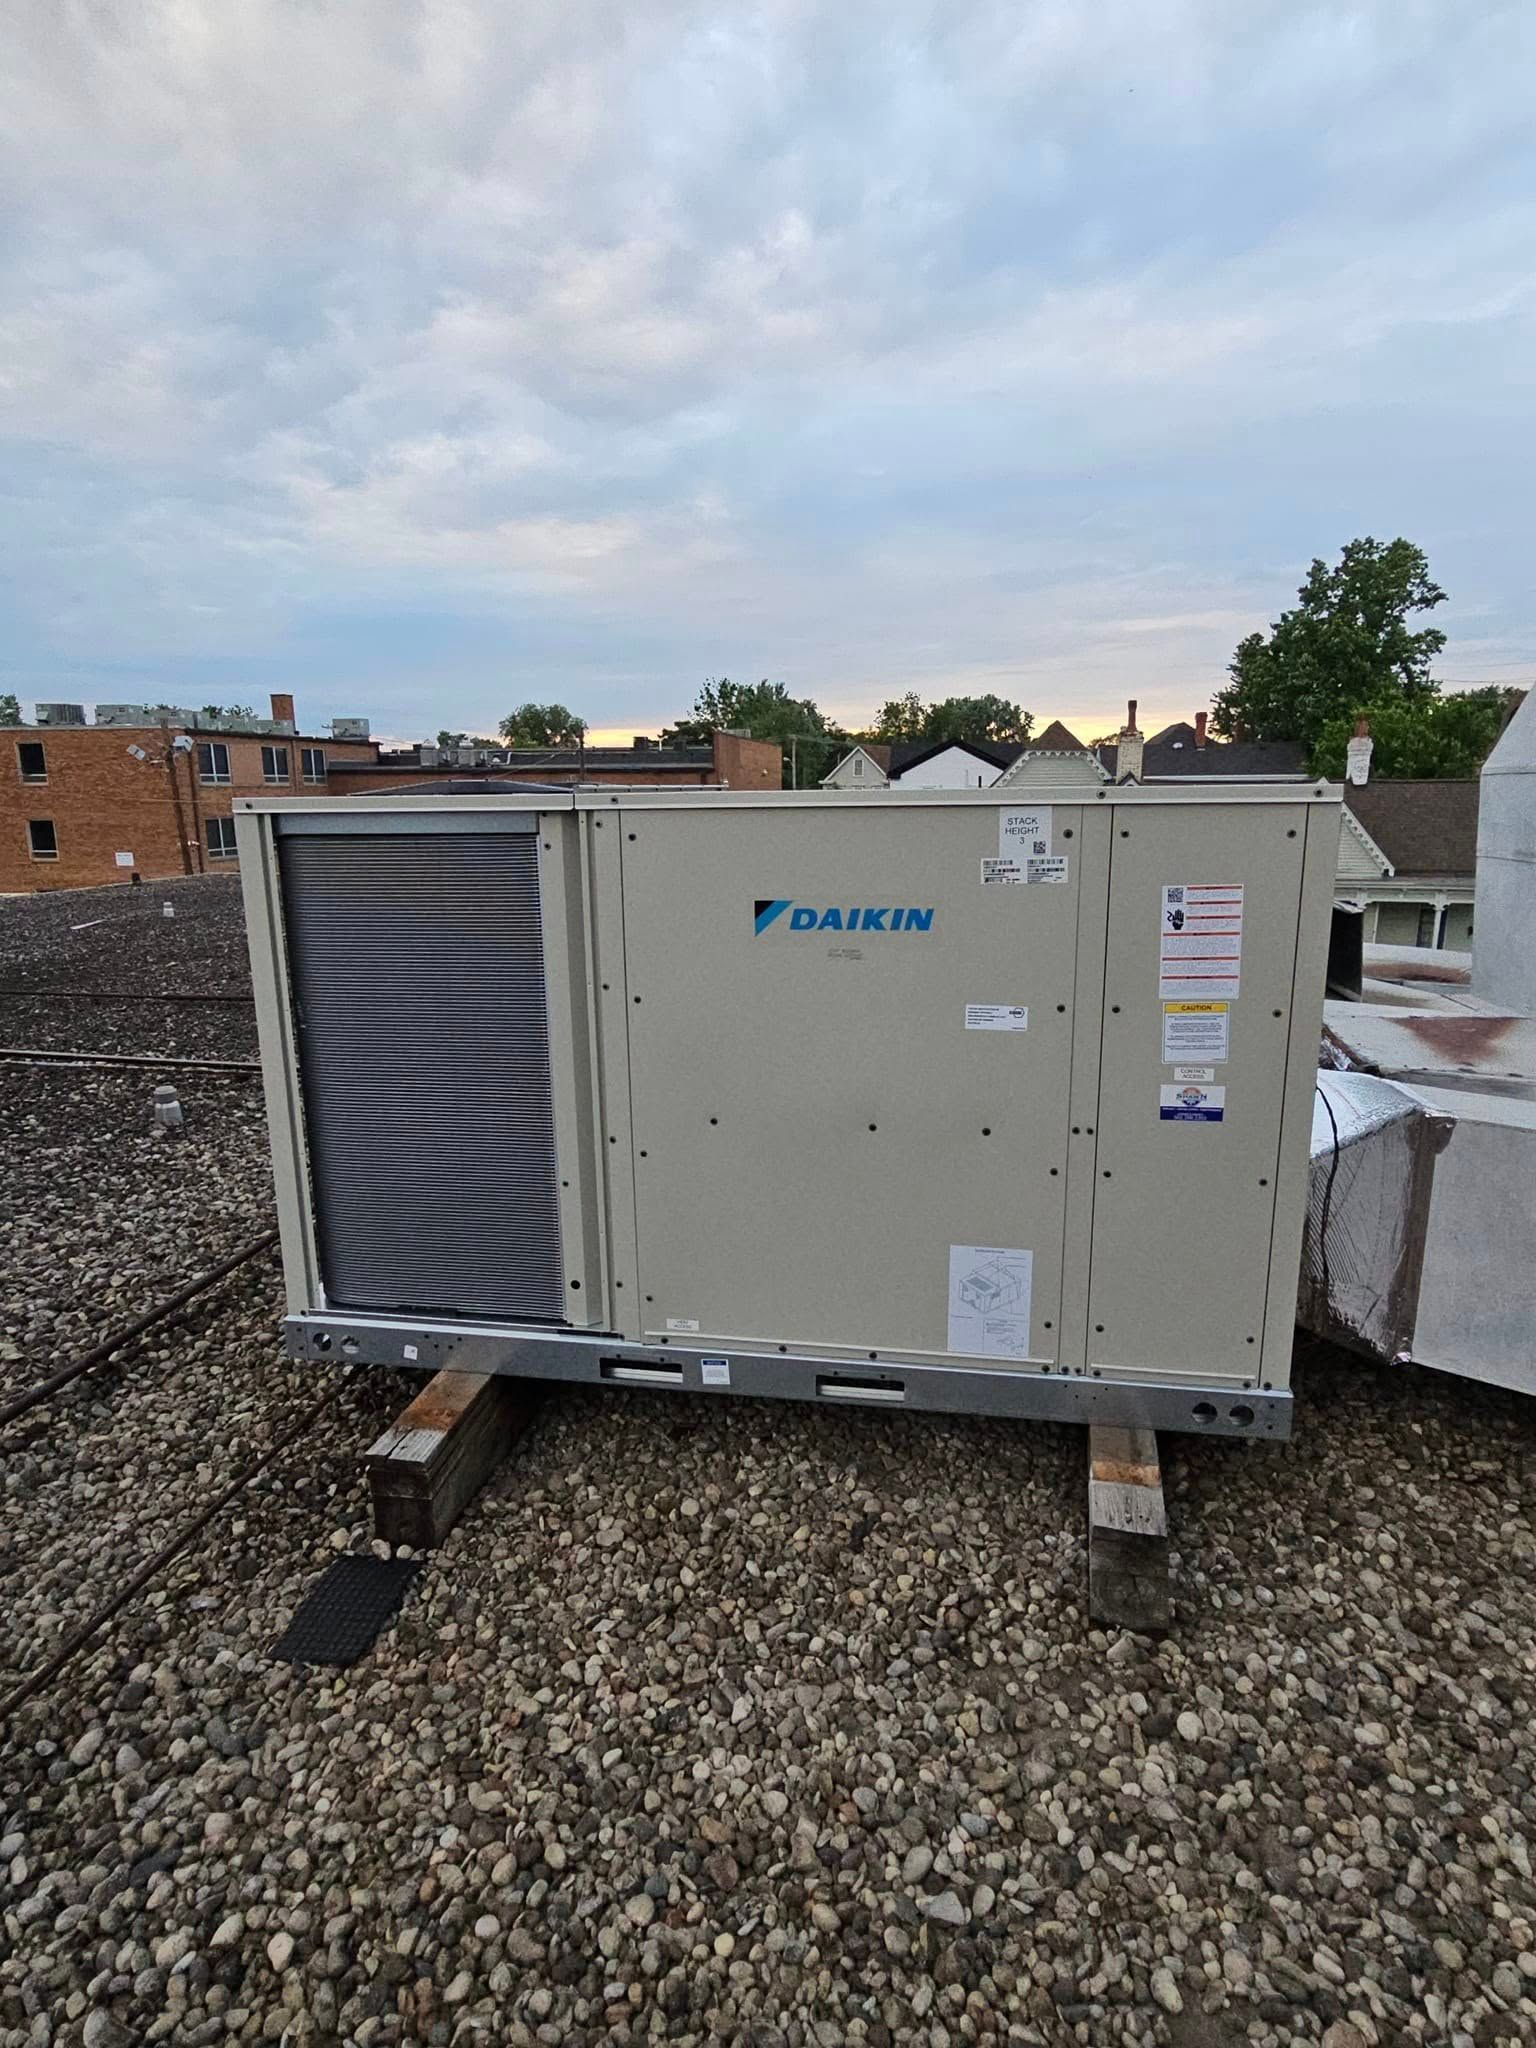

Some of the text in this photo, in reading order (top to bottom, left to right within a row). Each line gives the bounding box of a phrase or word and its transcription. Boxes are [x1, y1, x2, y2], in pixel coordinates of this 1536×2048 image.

[1007, 817, 1038, 826] STACK
[1005, 826, 1040, 835] HEIGHT
[1019, 836, 1025, 845] 3
[789, 908, 935, 931] DAIKIN
